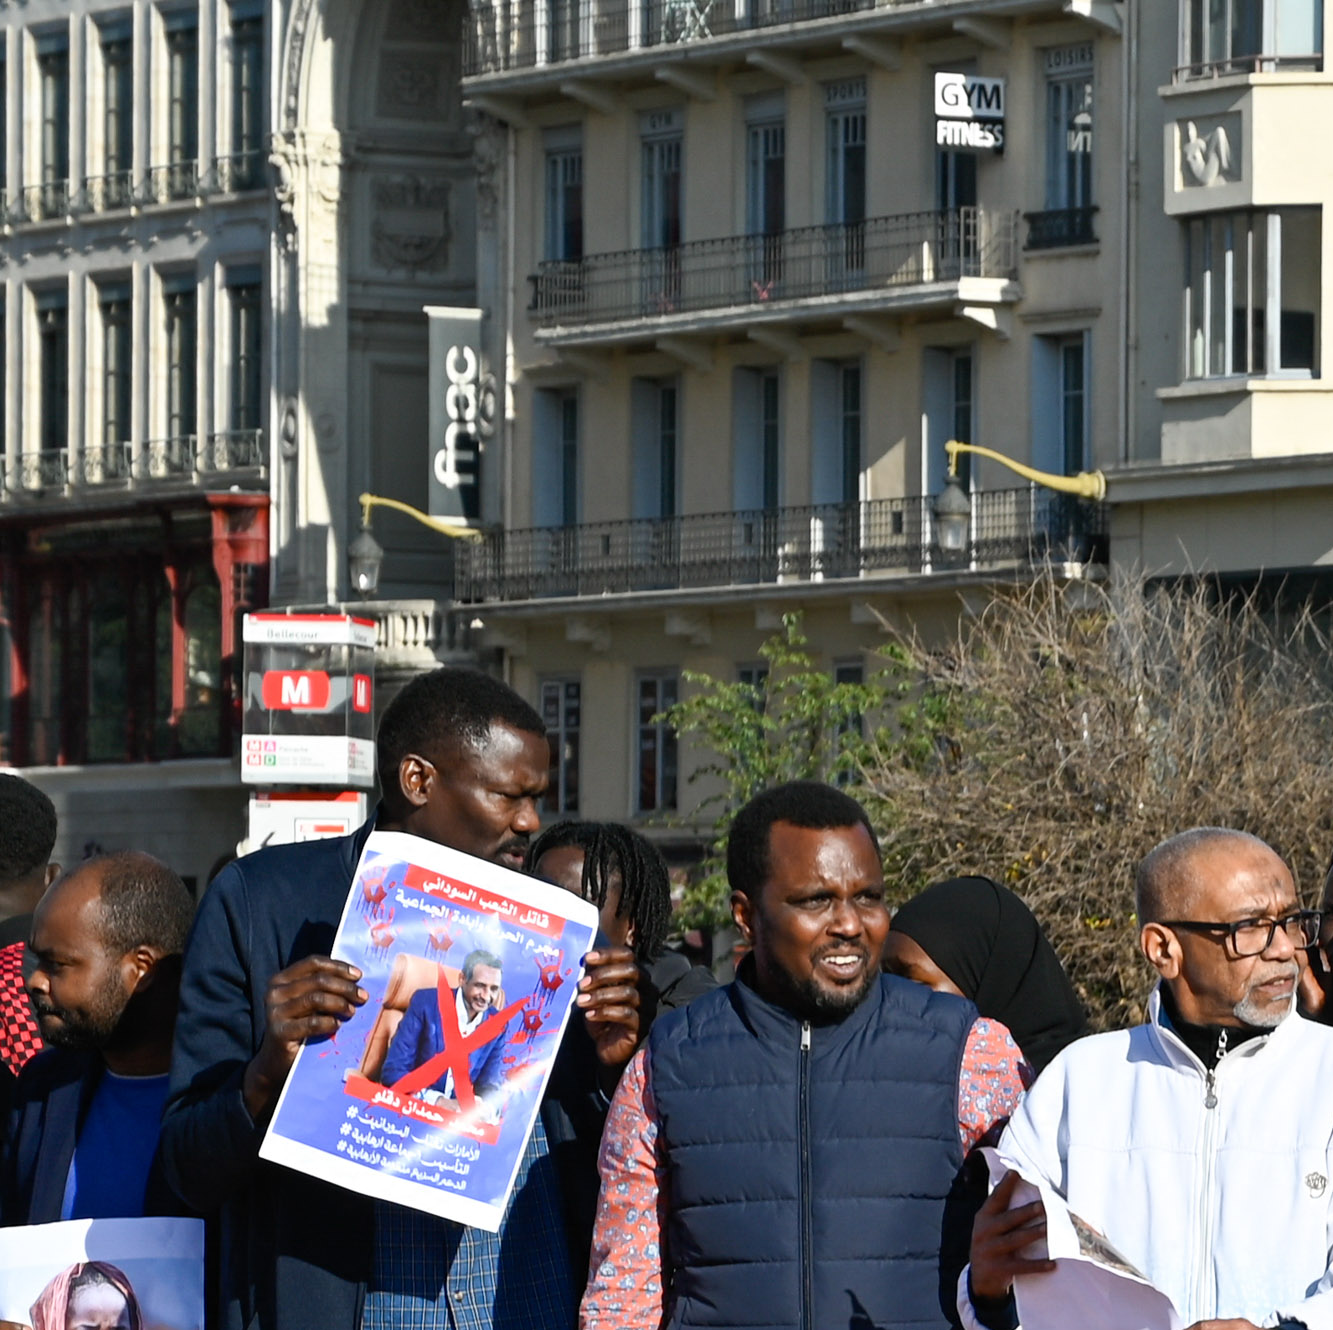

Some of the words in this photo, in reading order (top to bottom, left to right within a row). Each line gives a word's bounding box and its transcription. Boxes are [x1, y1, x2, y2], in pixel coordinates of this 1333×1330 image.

[1047, 46, 1094, 68] LOISIRS
[941, 82, 1002, 111] GYM
[936, 119, 1004, 148] FITNESS
[434, 345, 478, 490] fnac
[266, 628, 319, 640] Bellecour
[280, 675, 310, 705] M
[356, 678, 367, 707] M
[423, 878, 477, 902] السوداني
[395, 888, 450, 918] الجماعية
[479, 900, 517, 916] الشعب
[519, 910, 549, 929] قاتل
[526, 939, 560, 957] مجرم
[371, 1090, 400, 1108] دقلو
[402, 1101, 444, 1122] حمدان
[410, 1168, 440, 1183] السريع
[438, 1178, 467, 1190] الدعم
